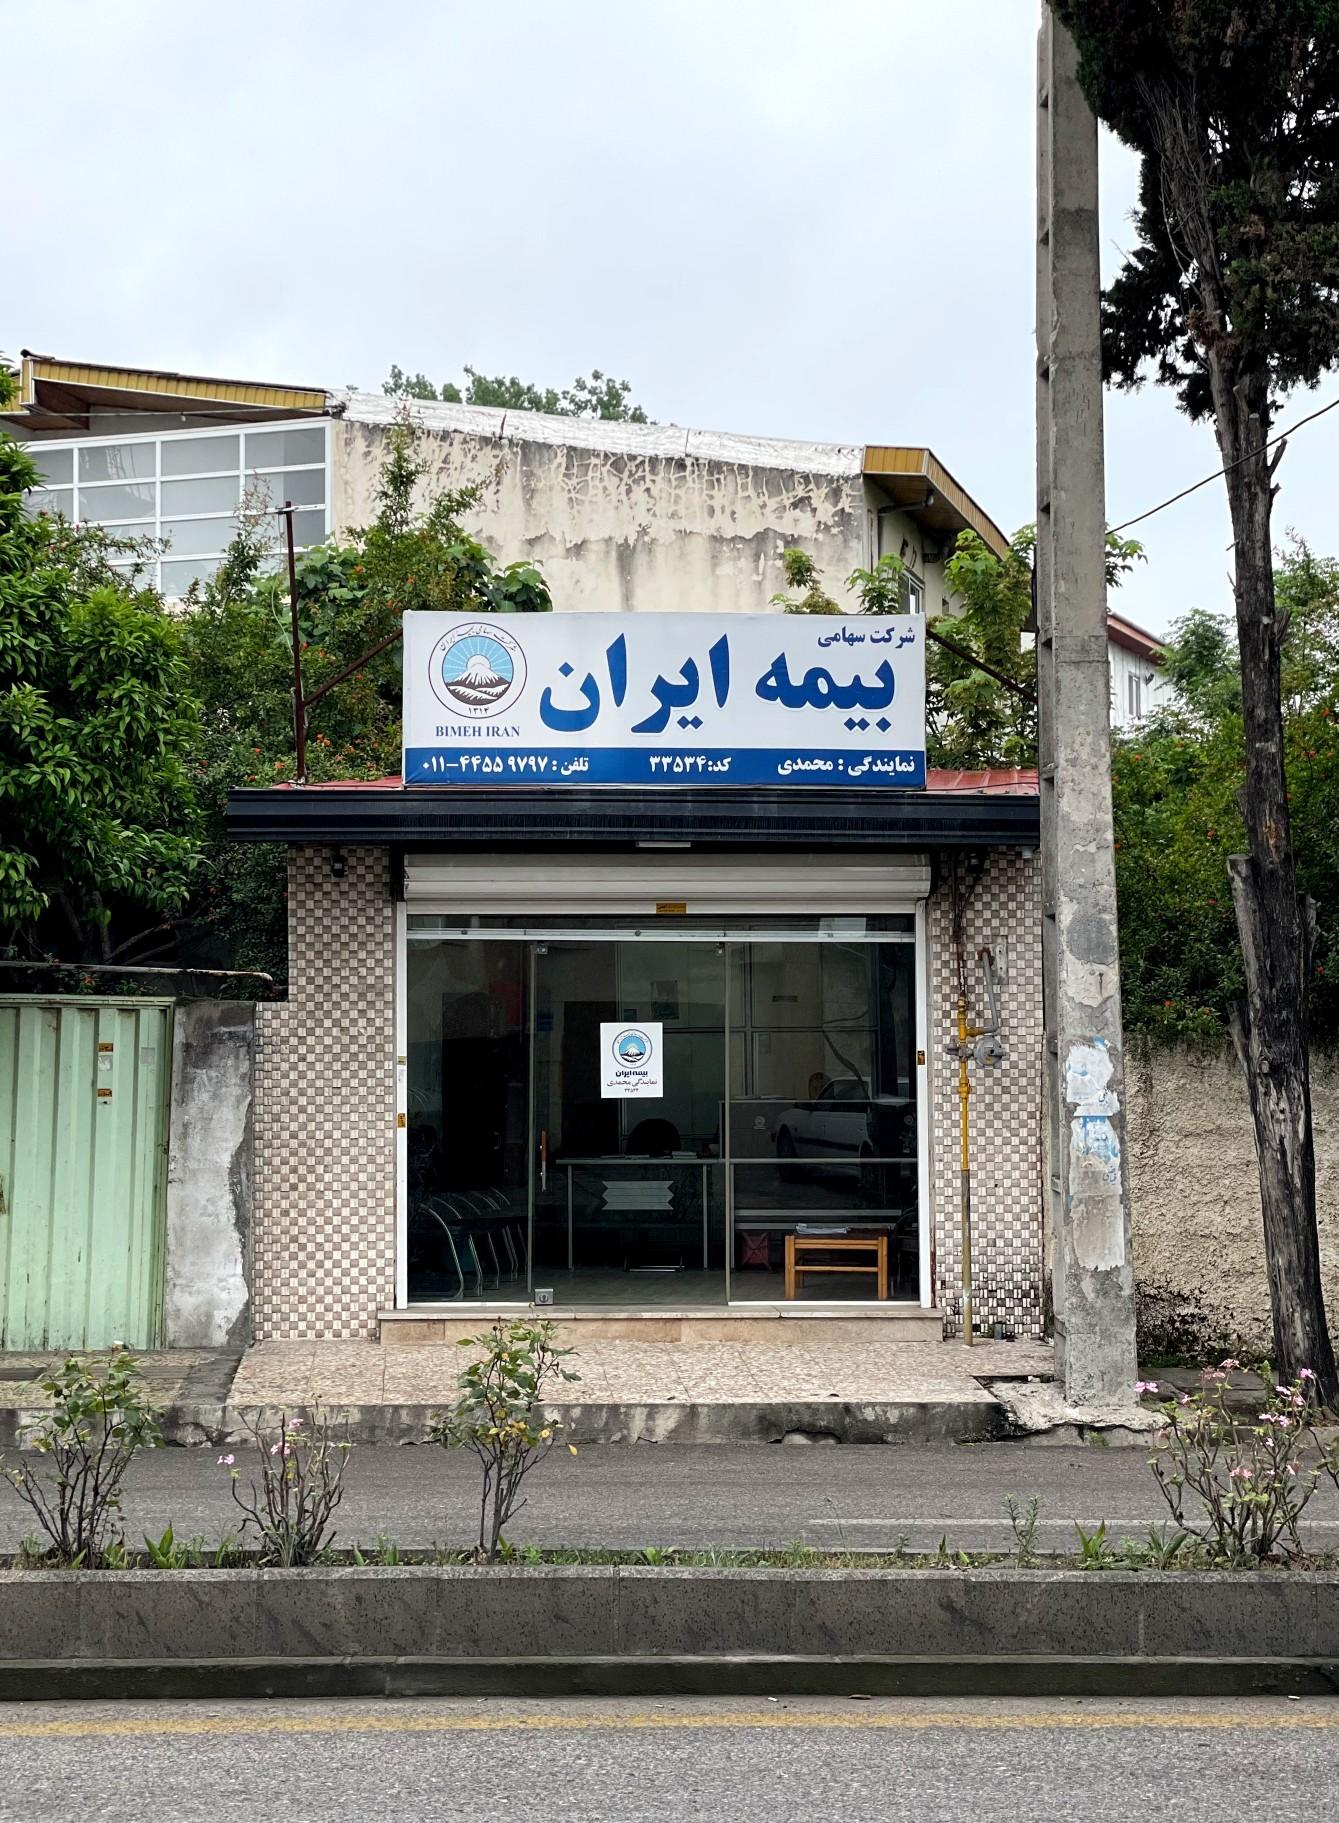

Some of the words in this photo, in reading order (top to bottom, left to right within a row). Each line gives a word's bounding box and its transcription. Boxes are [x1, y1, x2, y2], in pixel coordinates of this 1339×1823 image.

[817, 625, 866, 648] سهامی
[869, 626, 916, 649] شرکت
[539, 632, 732, 735] ایران
[754, 651, 897, 735] بیمه
[435, 725, 482, 737] BIMEH
[486, 725, 520, 737] IRAN
[777, 756, 834, 775] محمدی
[615, 1070, 632, 1078] ایران
